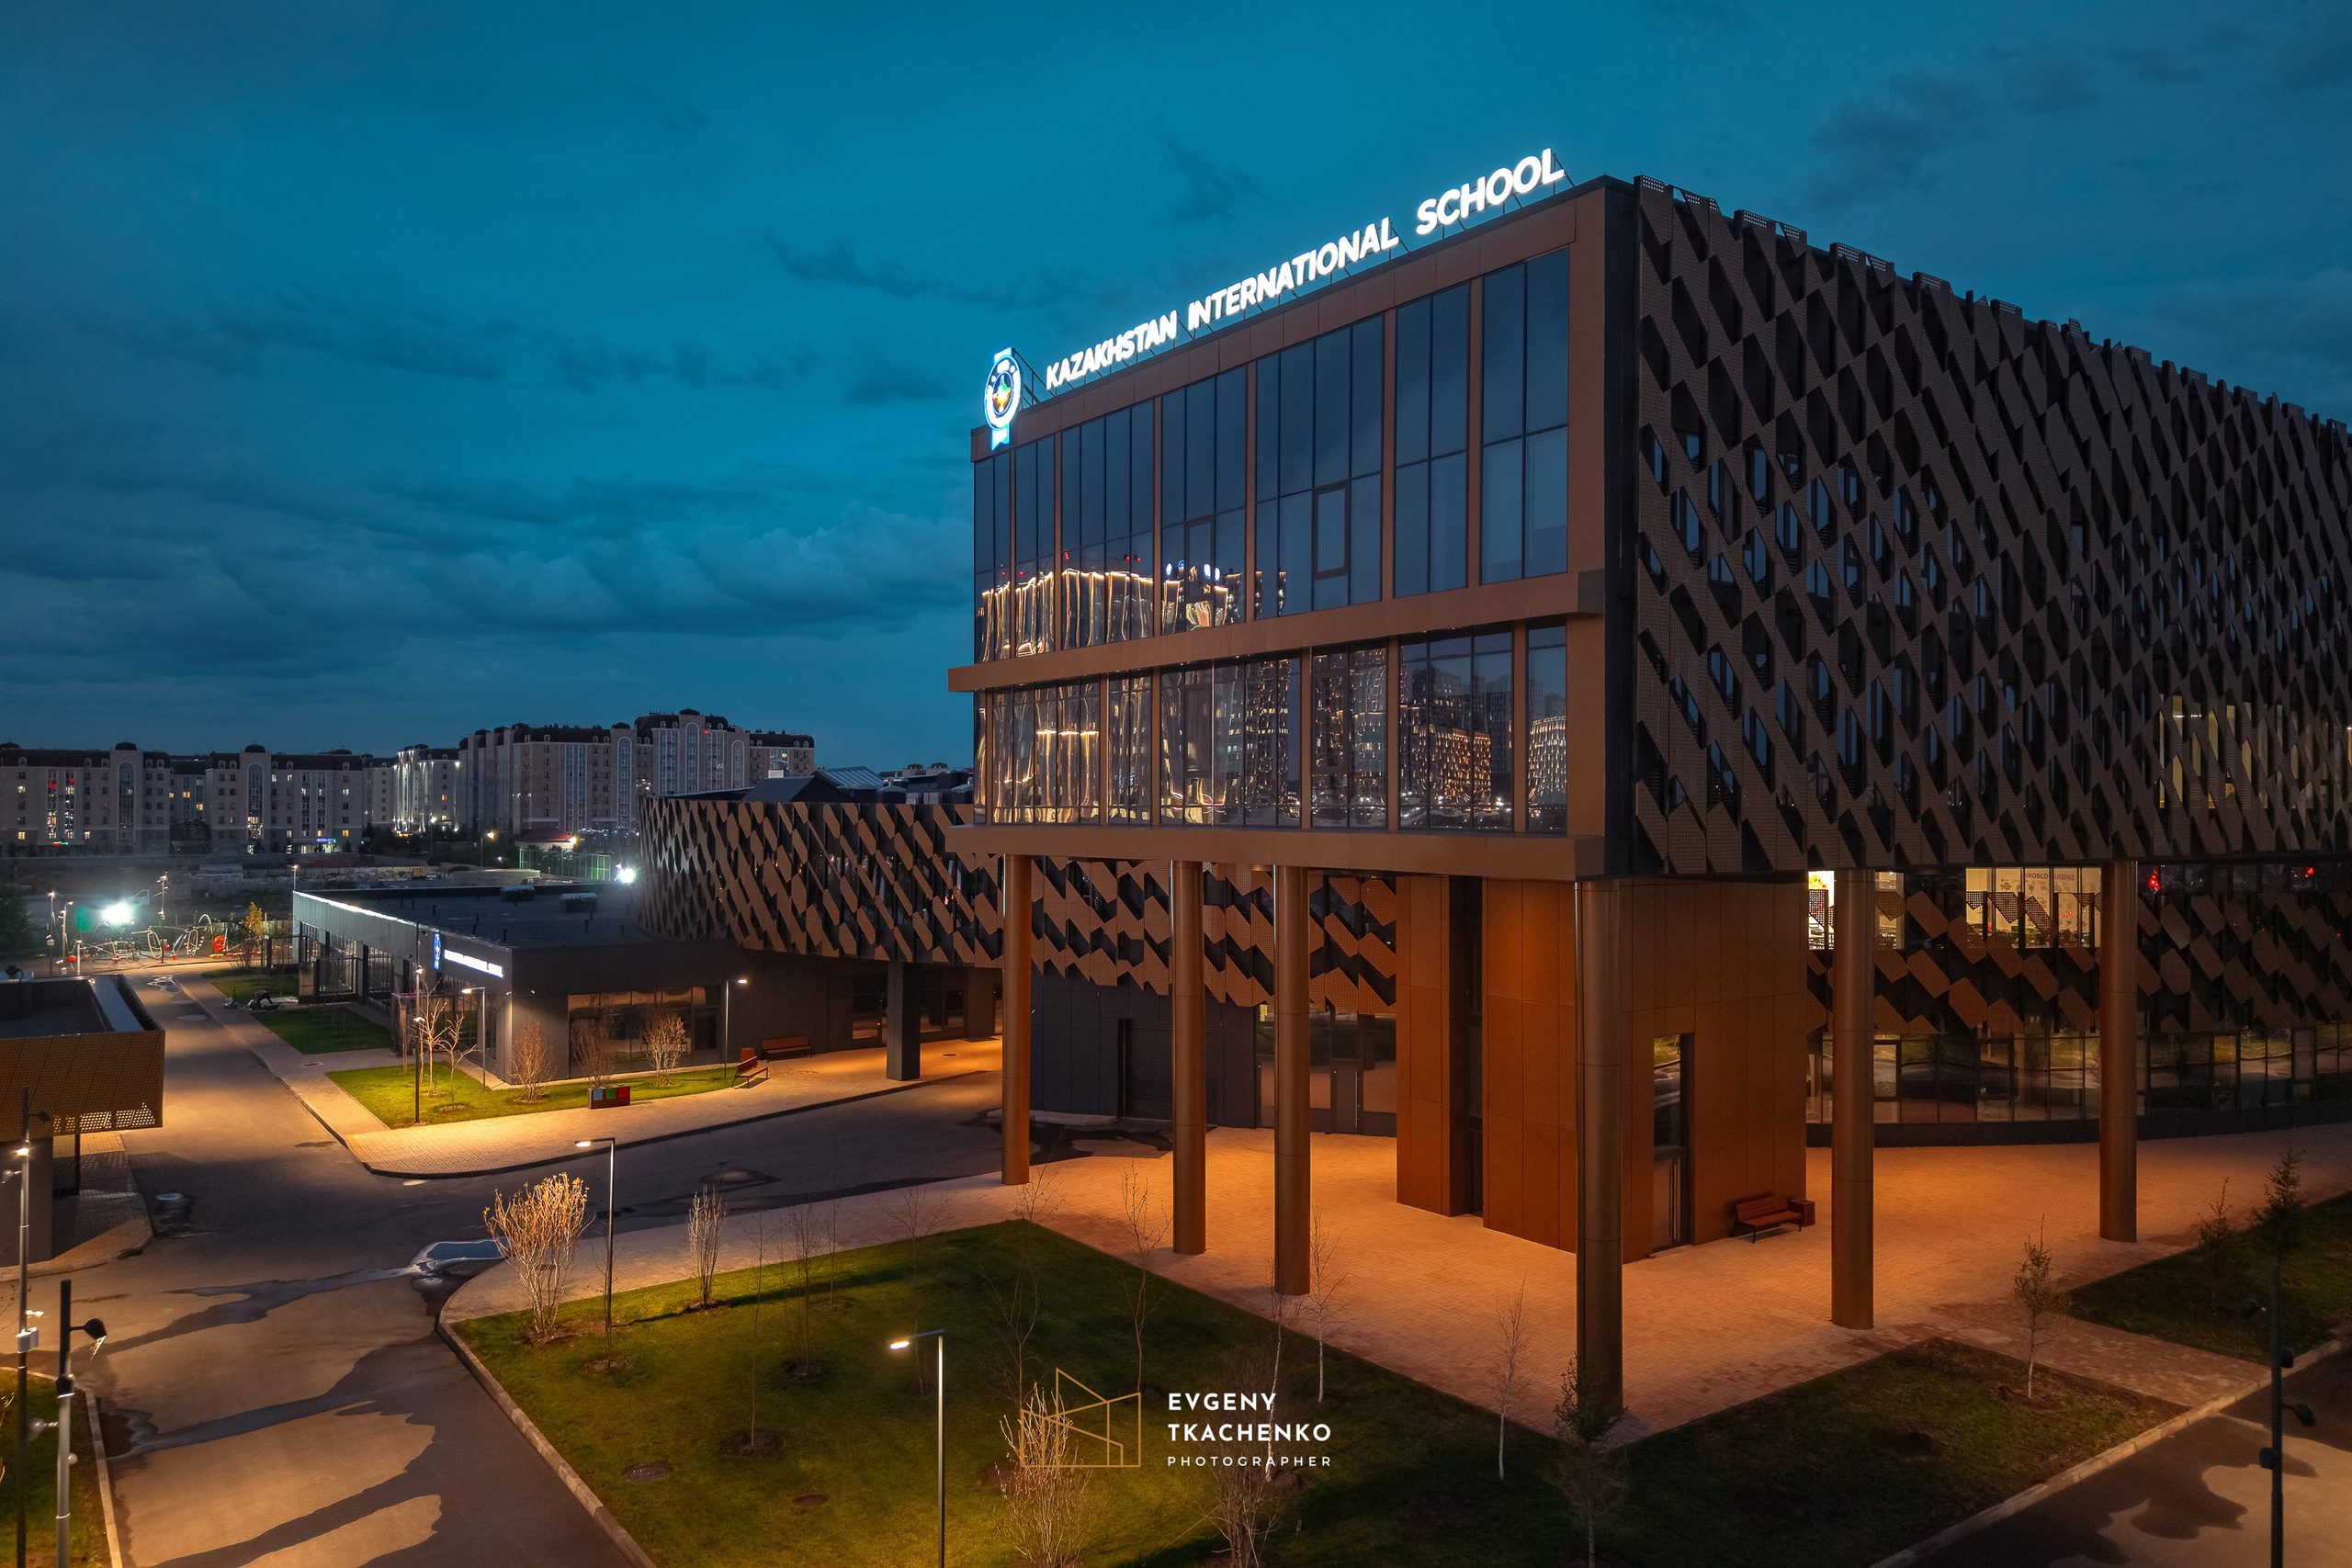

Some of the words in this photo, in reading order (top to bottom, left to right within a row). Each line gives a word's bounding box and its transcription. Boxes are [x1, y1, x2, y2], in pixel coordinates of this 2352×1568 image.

[1046, 310, 1177, 390] KAZAKHSTAN
[1188, 217, 1399, 331] INTERNATIONAL
[1416, 148, 1565, 235] SCHOOL
